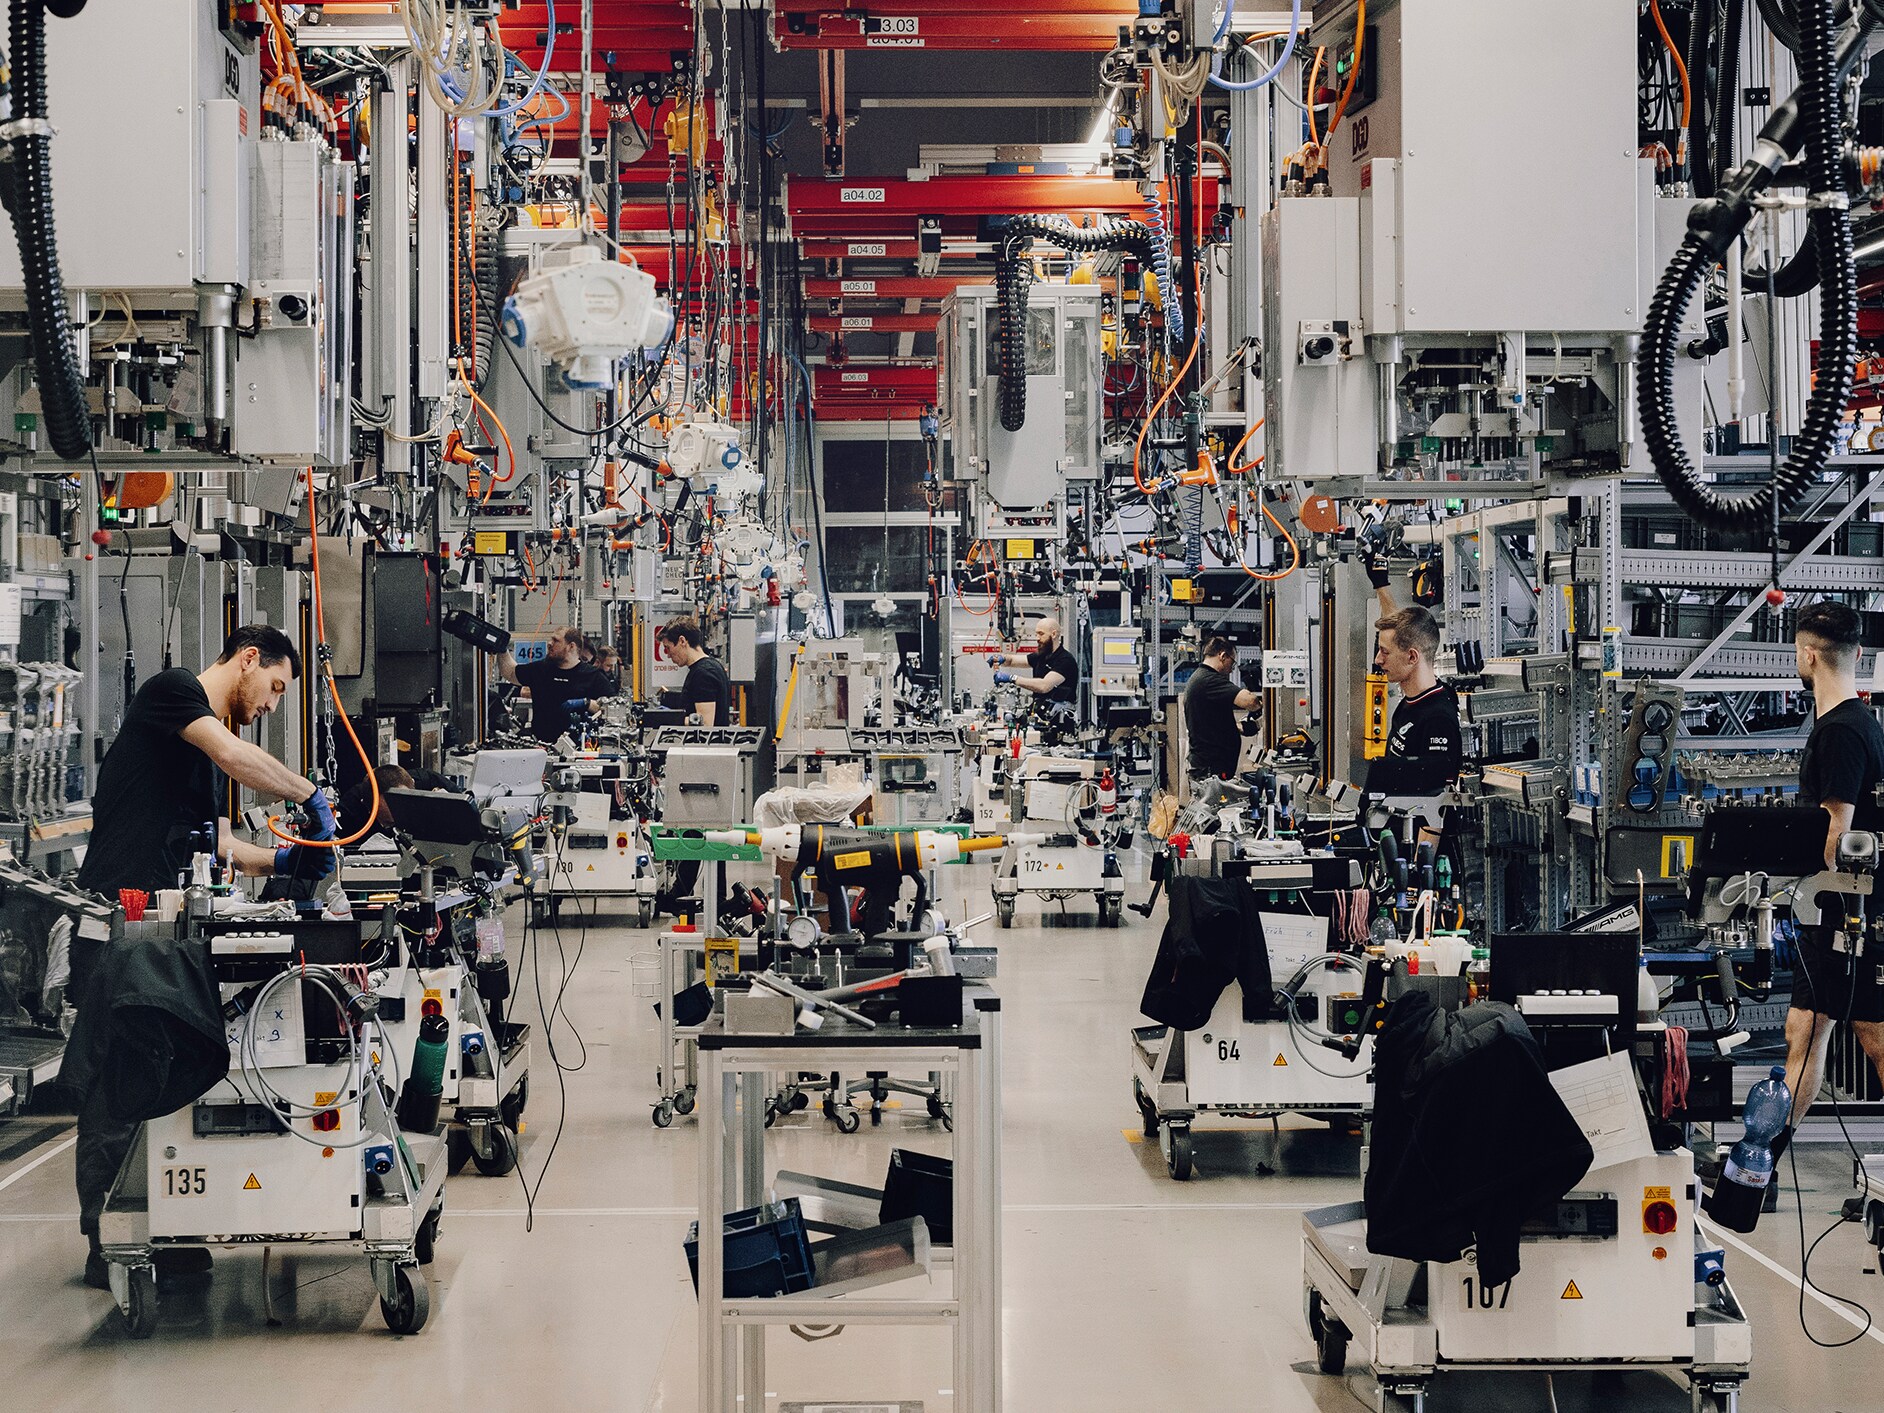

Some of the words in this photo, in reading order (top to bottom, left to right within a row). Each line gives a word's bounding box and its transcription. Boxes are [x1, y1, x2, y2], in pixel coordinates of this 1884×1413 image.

[882, 19, 916, 33] 3.03
[225, 46, 240, 95] DGD
[1352, 115, 1369, 156] DGD
[843, 190, 882, 201] a04.02
[850, 245, 883, 255] a04.05
[843, 282, 873, 291] a05.01
[844, 318, 870, 326] a06.01
[843, 373, 867, 381] a06.03
[518, 647, 543, 659] 465
[1430, 737, 1448, 745] TIBCO
[979, 809, 994, 819] 152
[1025, 860, 1042, 872] 172
[1599, 908, 1635, 931] AMG
[1218, 1040, 1241, 1062] 64
[1586, 1129, 1603, 1139] Takt
[165, 1168, 206, 1196] 135
